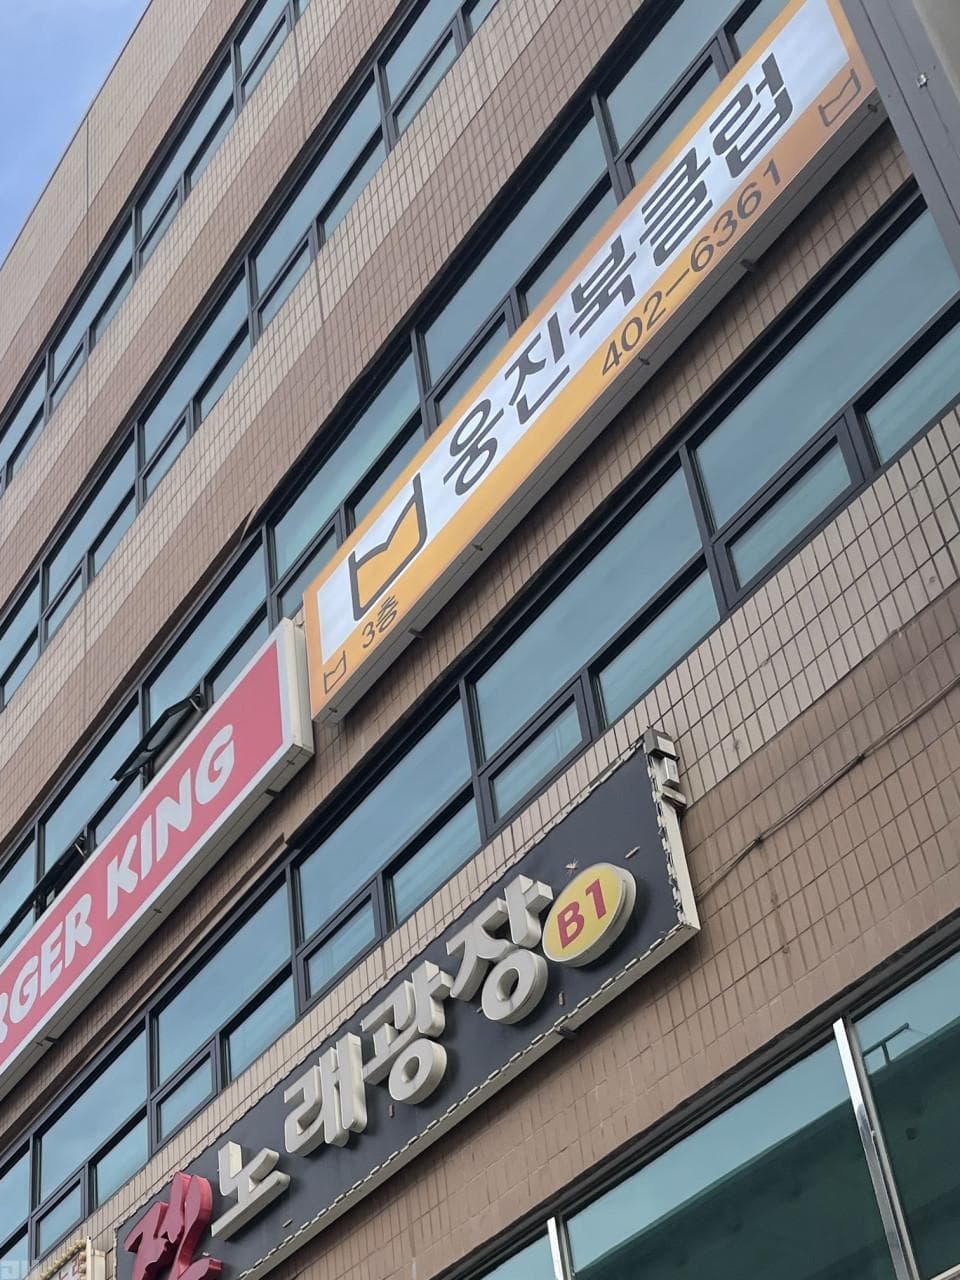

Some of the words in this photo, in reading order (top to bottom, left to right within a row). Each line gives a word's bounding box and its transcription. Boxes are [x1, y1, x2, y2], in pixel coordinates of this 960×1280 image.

[443, 52, 795, 499] 웅진북클럽
[599, 159, 783, 379] 402-6361
[361, 594, 399, 649] 3층
[105, 722, 236, 917] KING
[556, 879, 607, 950] B1
